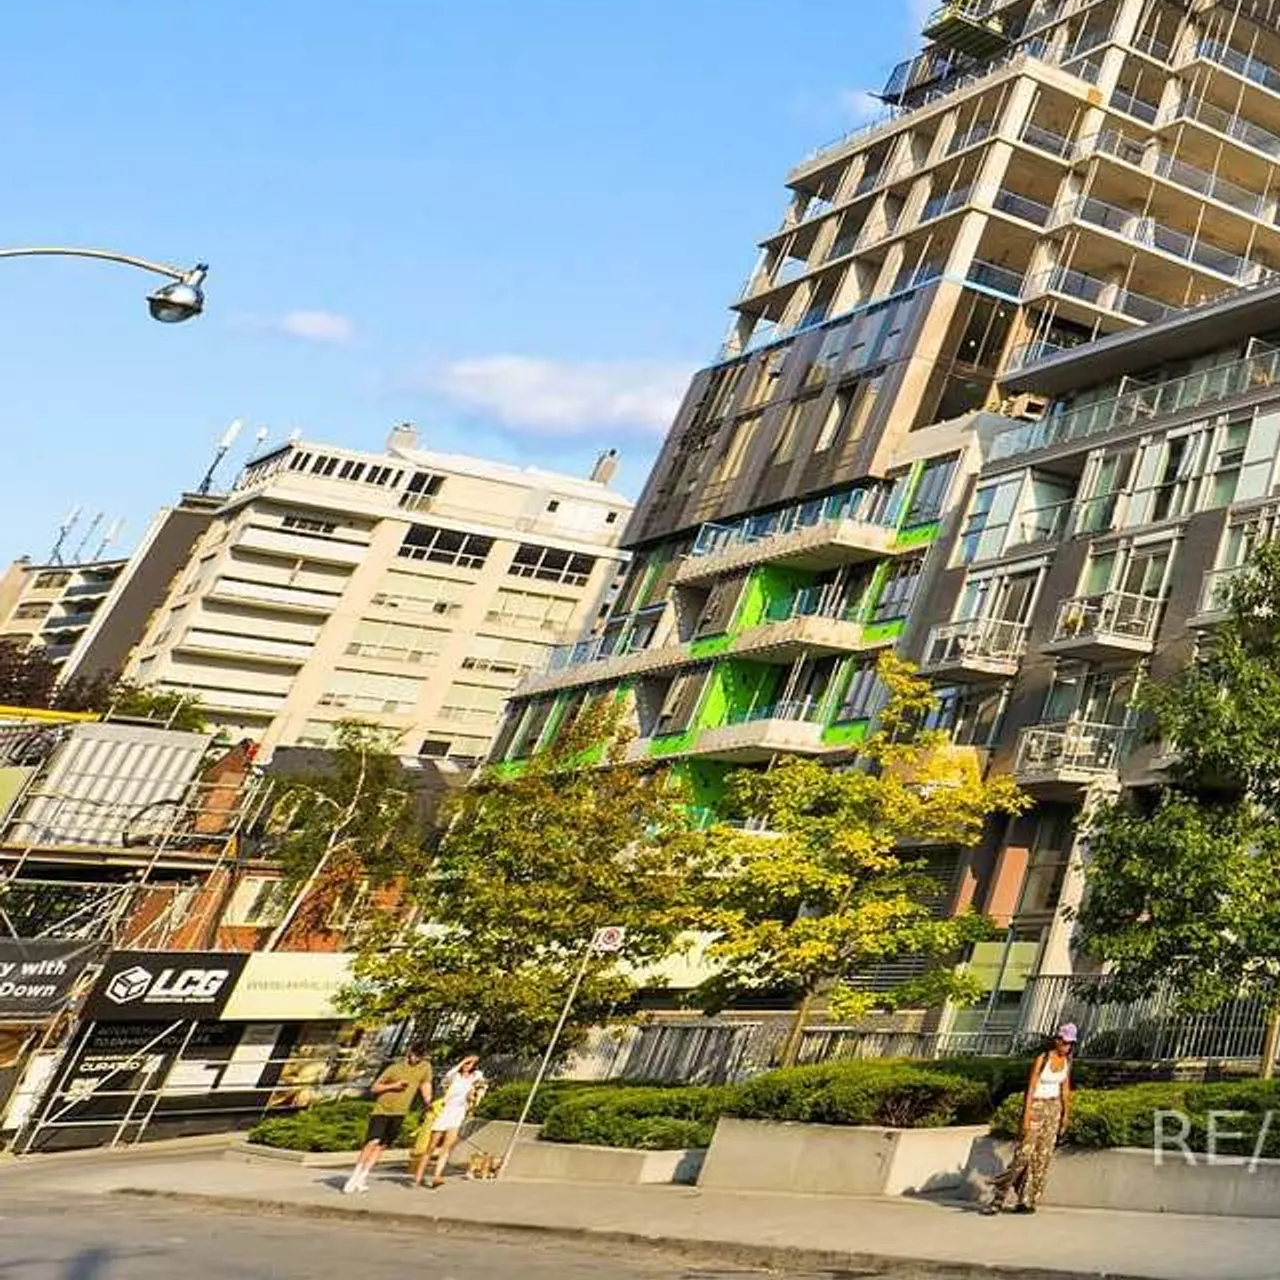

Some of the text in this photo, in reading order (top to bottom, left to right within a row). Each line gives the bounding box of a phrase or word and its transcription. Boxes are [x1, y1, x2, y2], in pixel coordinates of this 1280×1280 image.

[21, 959, 68, 976] with
[0, 981, 57, 998] Down
[146, 969, 230, 996] LCG
